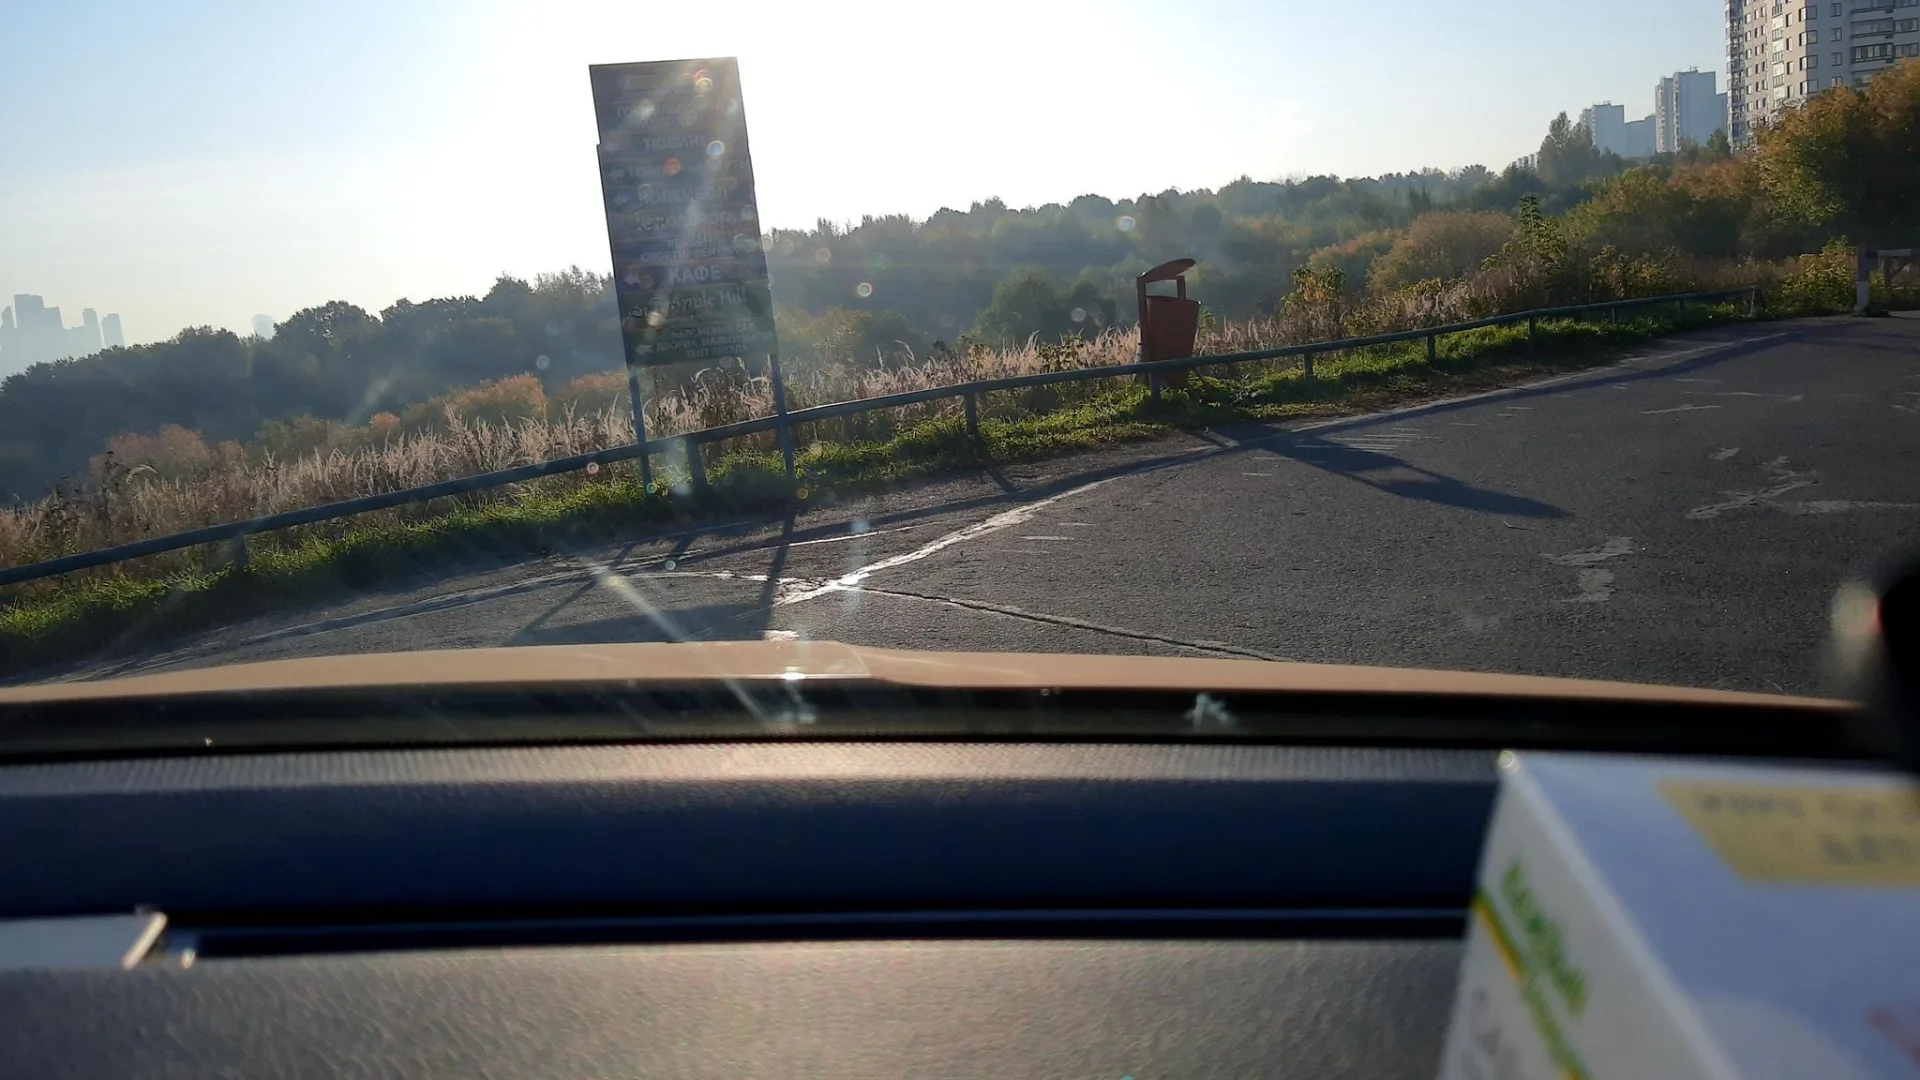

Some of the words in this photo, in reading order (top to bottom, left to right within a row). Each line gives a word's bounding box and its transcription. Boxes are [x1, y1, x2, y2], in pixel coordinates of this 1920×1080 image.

[667, 265, 721, 283] КАФЕ
[668, 291, 715, 311] Apple
[718, 287, 747, 304] Hill
